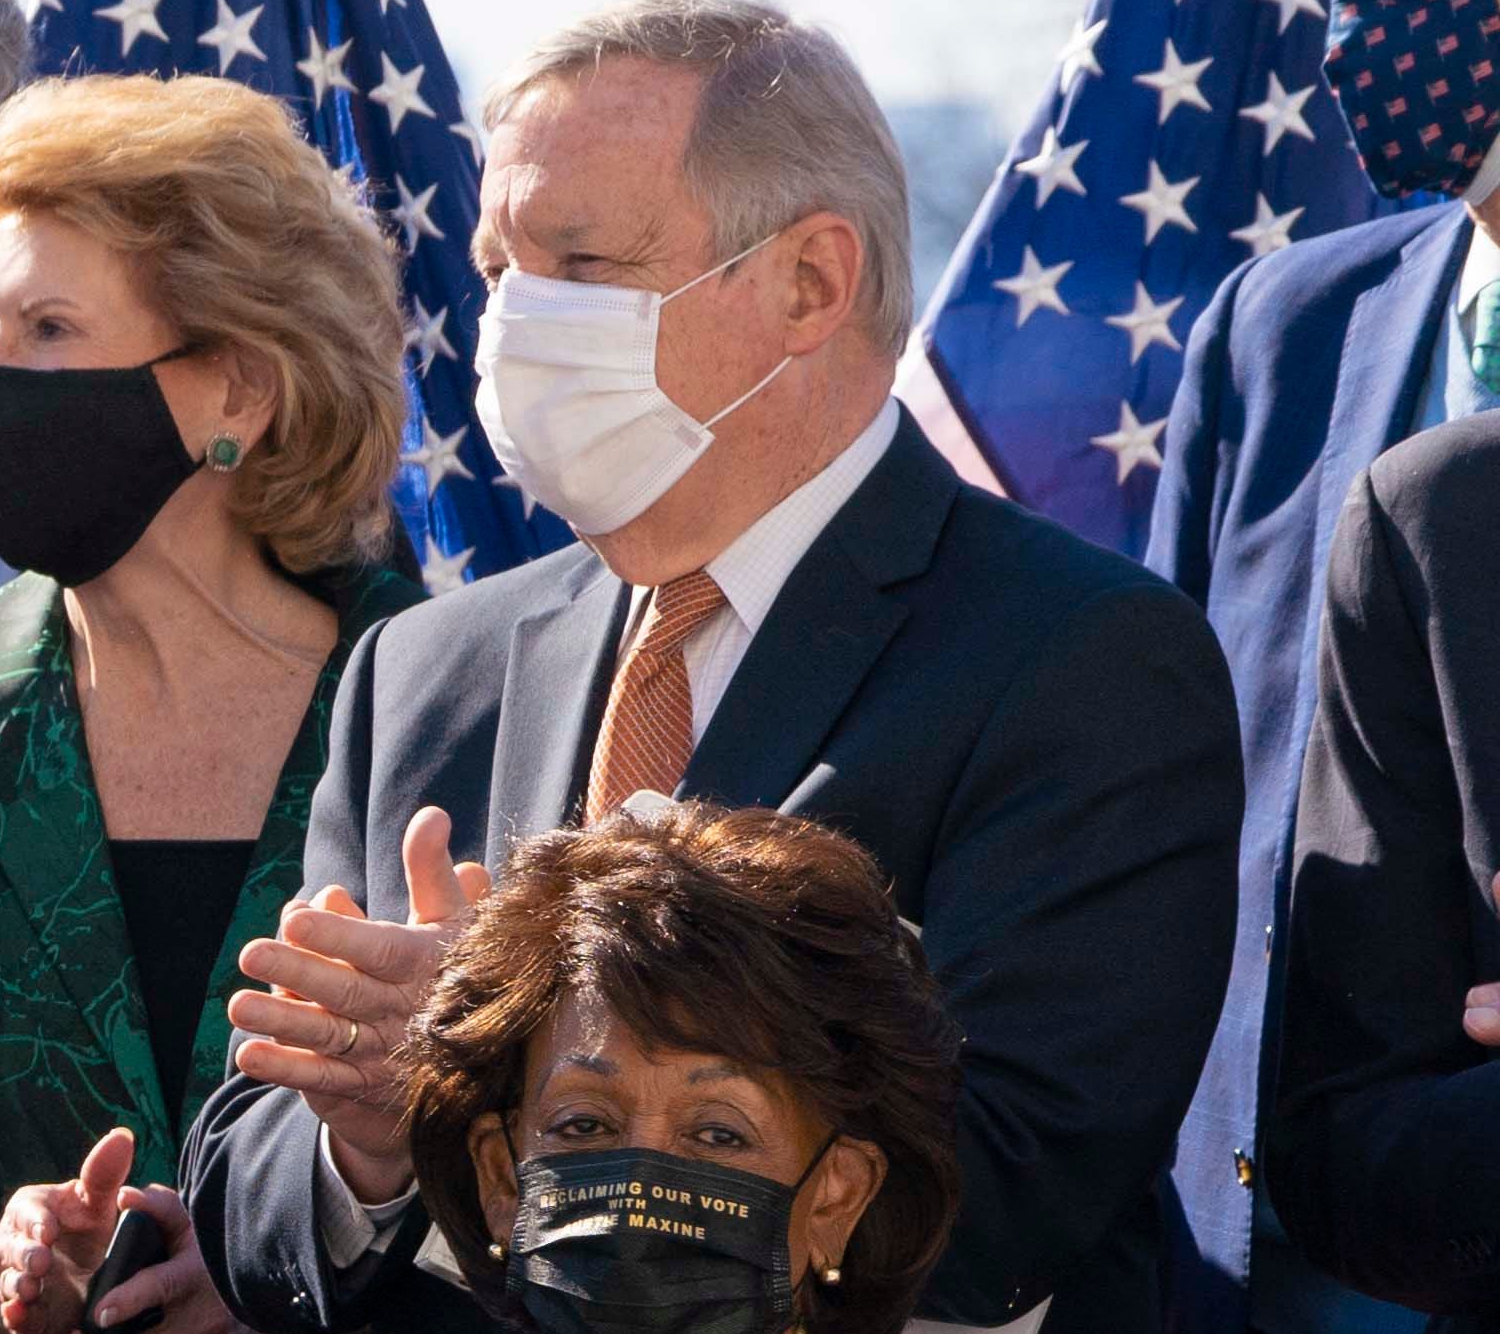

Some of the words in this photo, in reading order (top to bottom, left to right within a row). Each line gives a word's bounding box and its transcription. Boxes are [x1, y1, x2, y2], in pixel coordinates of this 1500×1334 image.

[539, 1181, 644, 1208] RECLAIMING
[651, 1185, 691, 1205] OUR
[699, 1195, 749, 1218] VOTE
[608, 1197, 647, 1210] WITH
[628, 1213, 706, 1240] MAXINE
